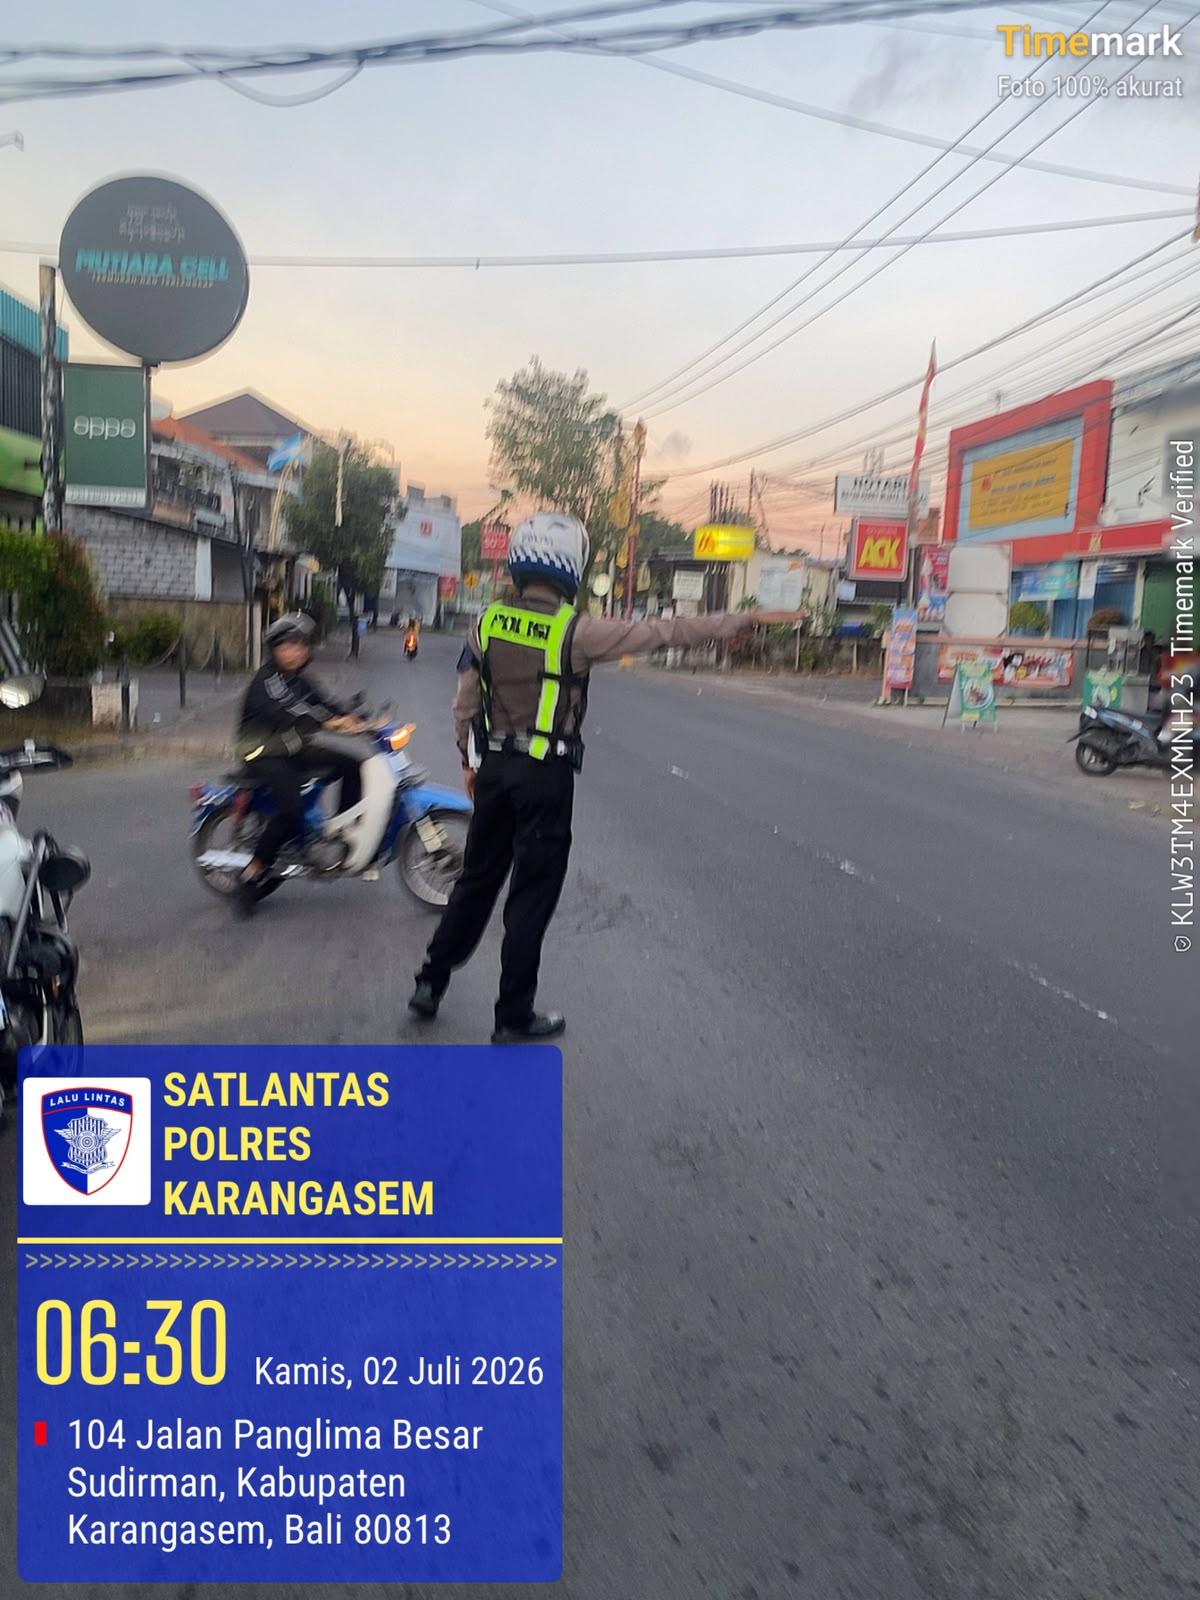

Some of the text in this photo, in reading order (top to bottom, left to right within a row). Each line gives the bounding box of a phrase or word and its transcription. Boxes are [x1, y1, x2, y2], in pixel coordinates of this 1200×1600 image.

[75, 248, 229, 281] MUTIARA CELL
[858, 534, 901, 568] ACK
